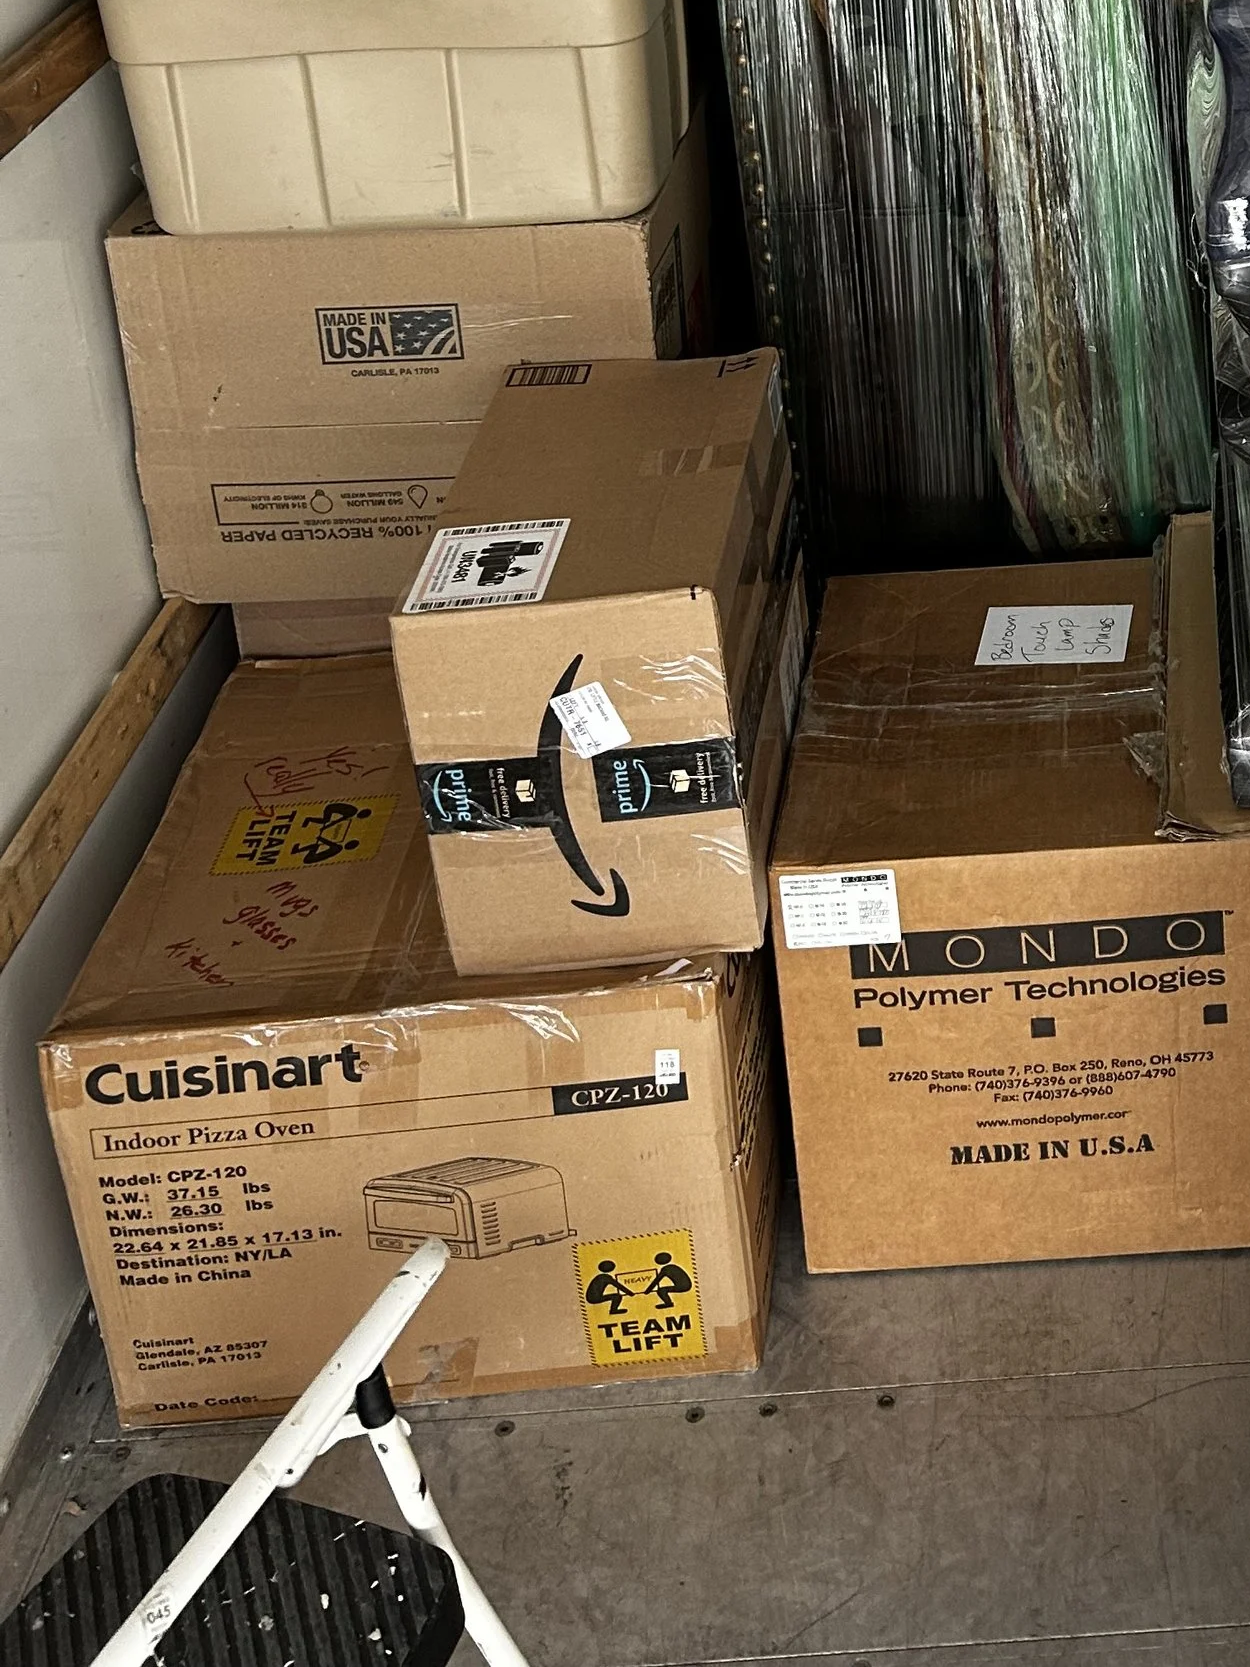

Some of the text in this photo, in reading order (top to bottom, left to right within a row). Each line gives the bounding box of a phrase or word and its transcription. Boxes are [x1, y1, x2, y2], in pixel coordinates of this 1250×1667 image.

[323, 312, 386, 326] MADE IN
[325, 326, 389, 359] USA
[351, 368, 398, 378] CARLISLE,
[414, 367, 440, 375] 17013
[251, 502, 290, 510] MILLION
[347, 499, 386, 508] MILLION
[333, 516, 378, 525] PURCHASE
[220, 525, 424, 542] 100% RECYCLED PAPER
[451, 550, 478, 583] UN3481
[990, 615, 1019, 661] Bedroom
[1021, 621, 1050, 662] Touch
[1055, 618, 1080, 651] Lamp
[612, 760, 638, 813] prime
[695, 752, 709, 804] free delivery
[445, 769, 472, 822] prime
[496, 767, 511, 819] free delivery
[236, 819, 265, 861] LIFT
[256, 810, 297, 866] TEAM
[868, 919, 1206, 973] MONDO
[853, 967, 1227, 1012] Polymer Technologies
[85, 1043, 363, 1105] Cuisinart
[888, 1051, 1214, 1082] 27620 State Route 7, P.O. Box 250, Reno, OH 45773
[928, 1066, 1176, 1094] Phone: (740)376-9396 or (888)607-4790
[571, 1083, 669, 1107] CPZ-120
[994, 1085, 1113, 1103] Fax: (740)376-9960
[103, 1121, 316, 1153] Indoor Pizza Oven
[950, 1133, 1156, 1166] MADE IN U.S.A
[98, 1165, 248, 1188] Model: CPZ-120
[102, 1182, 271, 1205] G.W.: 37.15 lbs
[105, 1199, 274, 1222] N.W.: 26.30 lbs
[109, 1221, 225, 1238] Dimensions:
[113, 1227, 343, 1254] 22.64 x 21.85 x 17.13 in.
[116, 1247, 293, 1271] Destination: NY/LA
[120, 1268, 252, 1287] Made in China
[624, 1275, 652, 1285] HEAVY
[598, 1314, 691, 1338] TEAM
[133, 1337, 195, 1349] Cuisinart
[136, 1340, 268, 1360] Glendale, AZ 85307
[612, 1333, 684, 1354] LIFT
[138, 1352, 262, 1371] Carlisle, PA 17013
[154, 1395, 260, 1412] Date Code:
